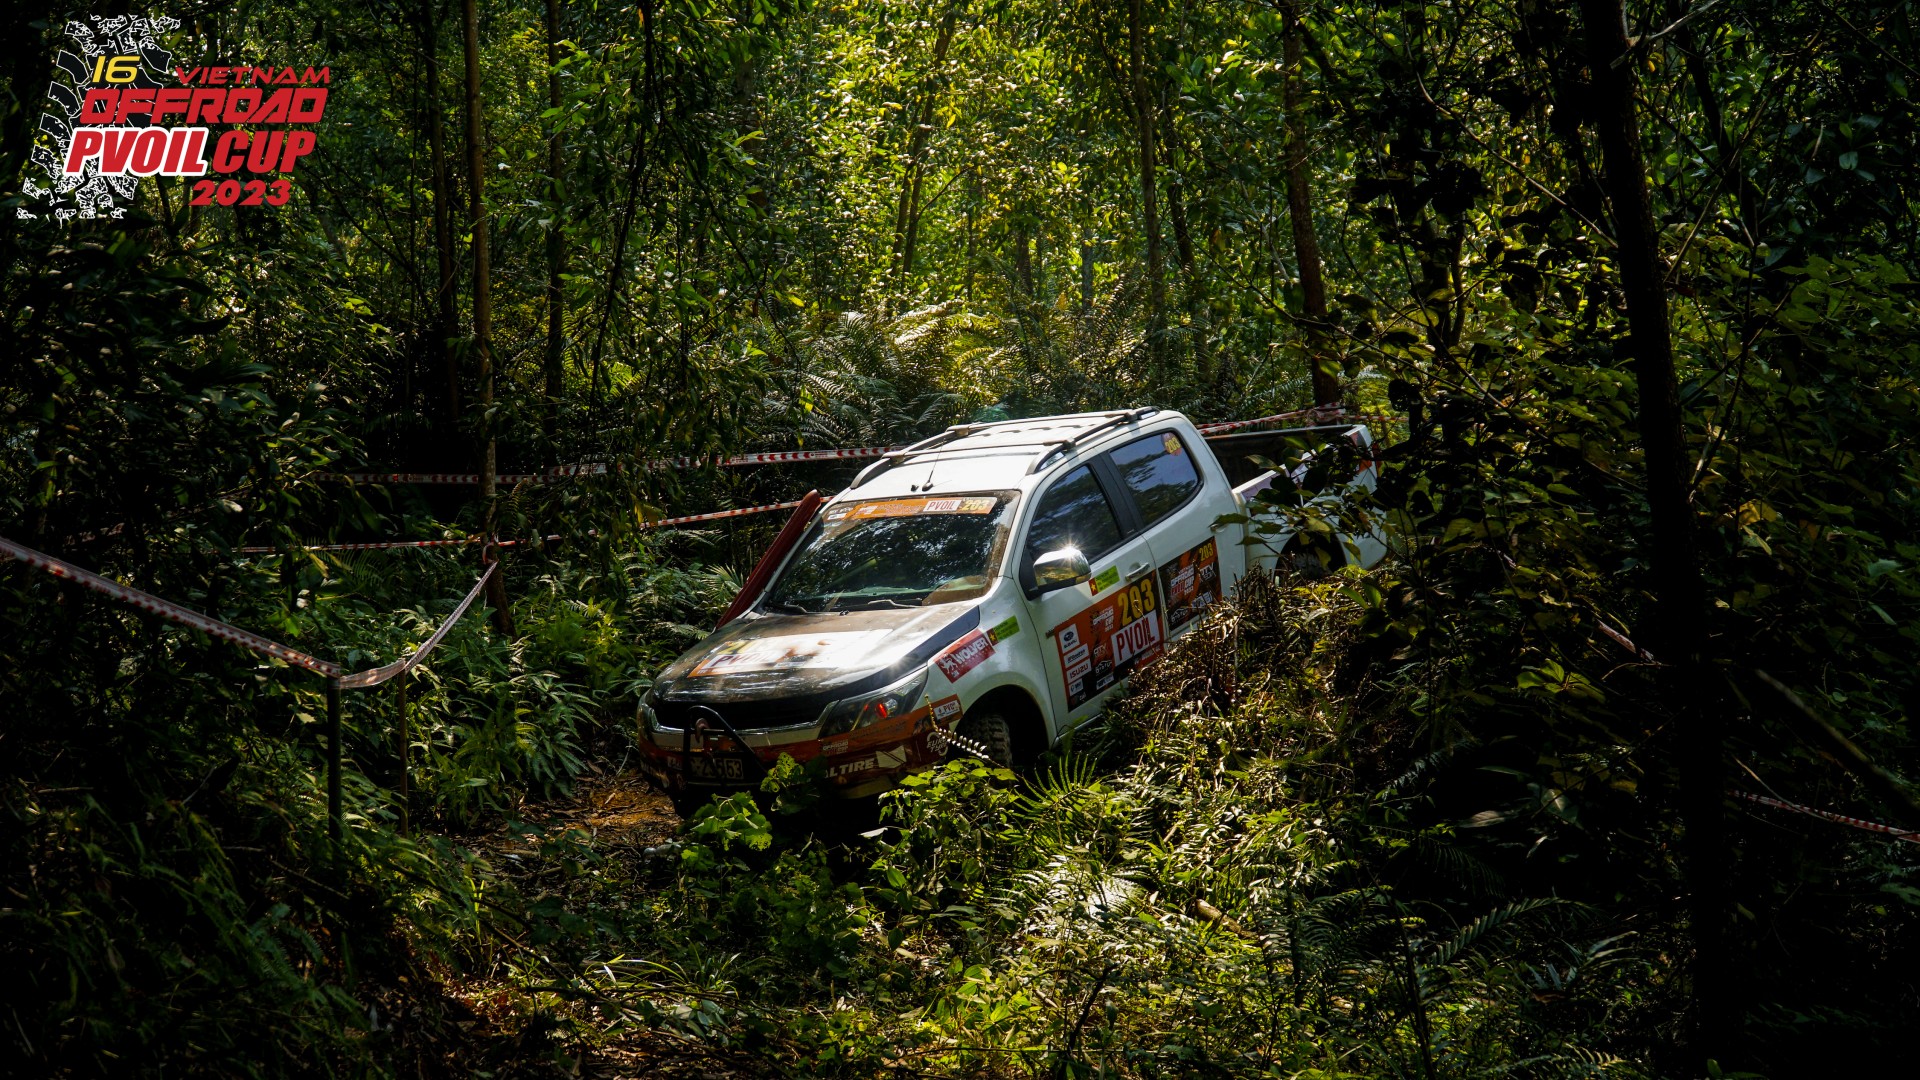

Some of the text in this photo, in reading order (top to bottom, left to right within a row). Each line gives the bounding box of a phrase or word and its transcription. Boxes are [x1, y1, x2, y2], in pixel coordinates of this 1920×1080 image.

[1164, 437, 1181, 454] 203
[926, 500, 956, 511] PVOIL
[961, 499, 990, 511] 203
[1199, 542, 1214, 562] 203
[1117, 578, 1155, 627] 203
[1115, 617, 1156, 661] PVOIL
[950, 637, 989, 665] WOLVER
[1069, 663, 1089, 679] ISUZU
